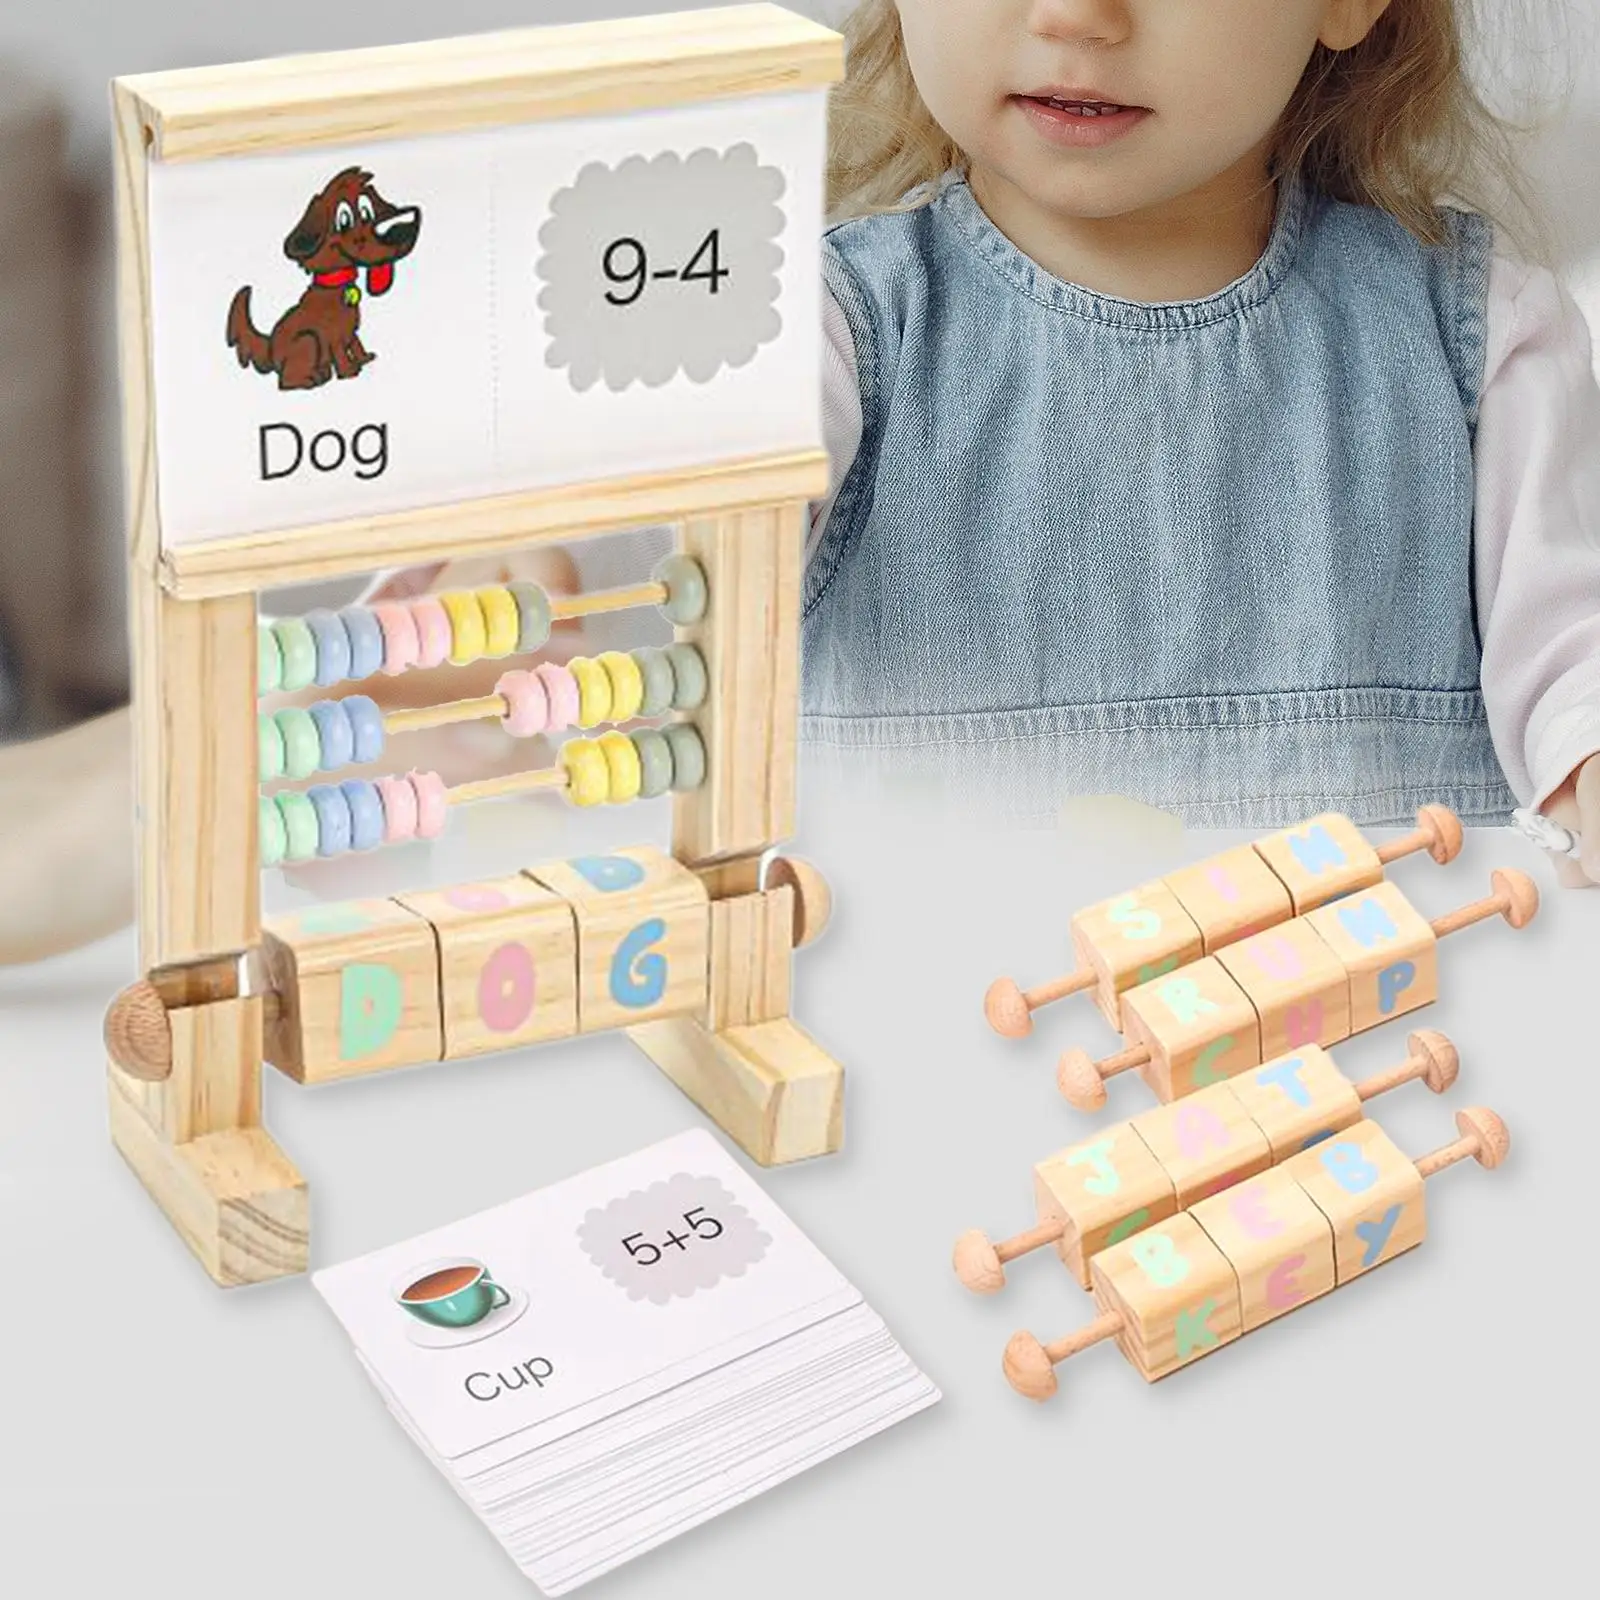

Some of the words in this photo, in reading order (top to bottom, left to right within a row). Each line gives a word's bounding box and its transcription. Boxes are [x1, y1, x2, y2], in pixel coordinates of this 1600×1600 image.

[602, 229, 729, 306] 9-4
[258, 421, 389, 481] Dog
[339, 917, 669, 1061] DOG
[621, 1206, 724, 1266] 5+5
[463, 1355, 554, 1402] Cup
